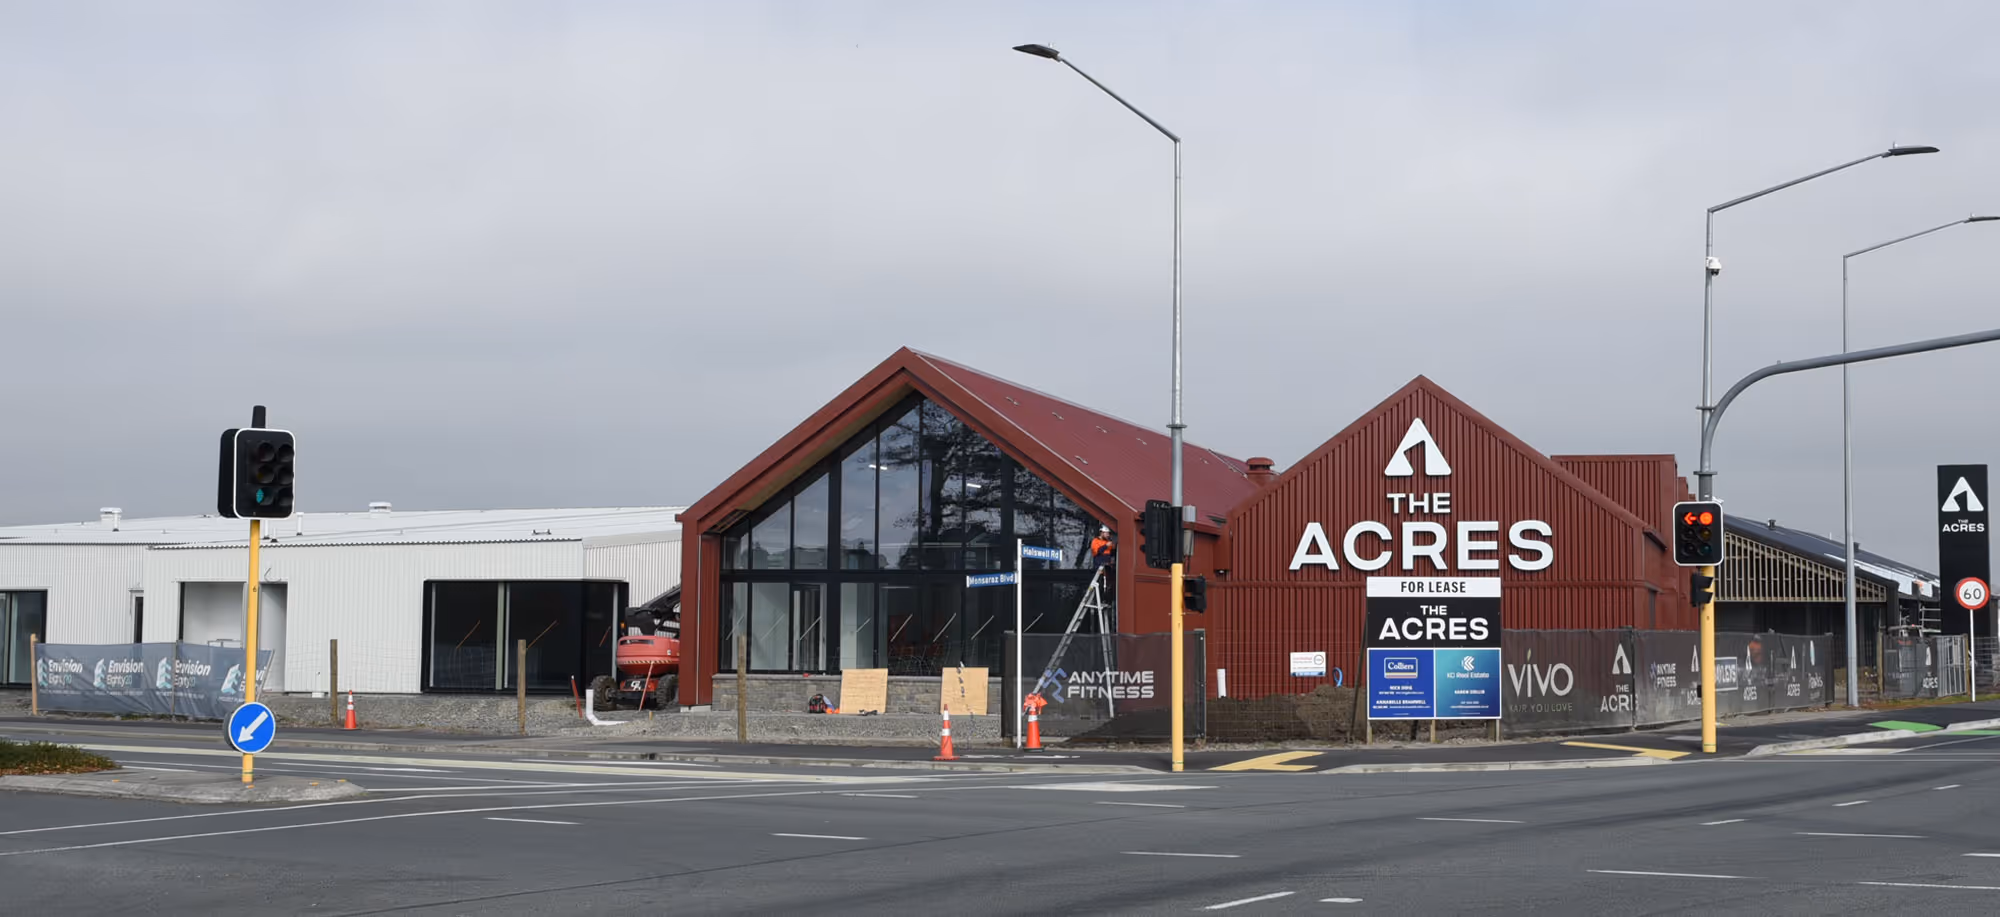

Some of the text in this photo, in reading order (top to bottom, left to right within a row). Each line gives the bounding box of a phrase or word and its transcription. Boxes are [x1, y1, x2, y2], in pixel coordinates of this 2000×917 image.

[1386, 492, 1451, 514] THE
[1942, 523, 1985, 532] ACRES
[1288, 520, 1554, 571] ACRES
[1022, 547, 1059, 559] Halswell Rd
[1000, 573, 1014, 583] Blvd
[1401, 581, 1466, 593] FOR LEASE
[1963, 587, 1981, 600] 60
[1420, 605, 1448, 615] THE
[1378, 617, 1489, 640] ACRES
[48, 657, 83, 673] Envision
[108, 658, 144, 673] Envision
[174, 659, 211, 676] Envision
[1387, 661, 1414, 670] Colliers
[1068, 670, 1155, 684] ANYTIME
[1067, 685, 1155, 699] FITNESS
[1616, 684, 1629, 693] THE
[1530, 703, 1549, 713] YOU
[1551, 702, 1573, 712] LOVE
